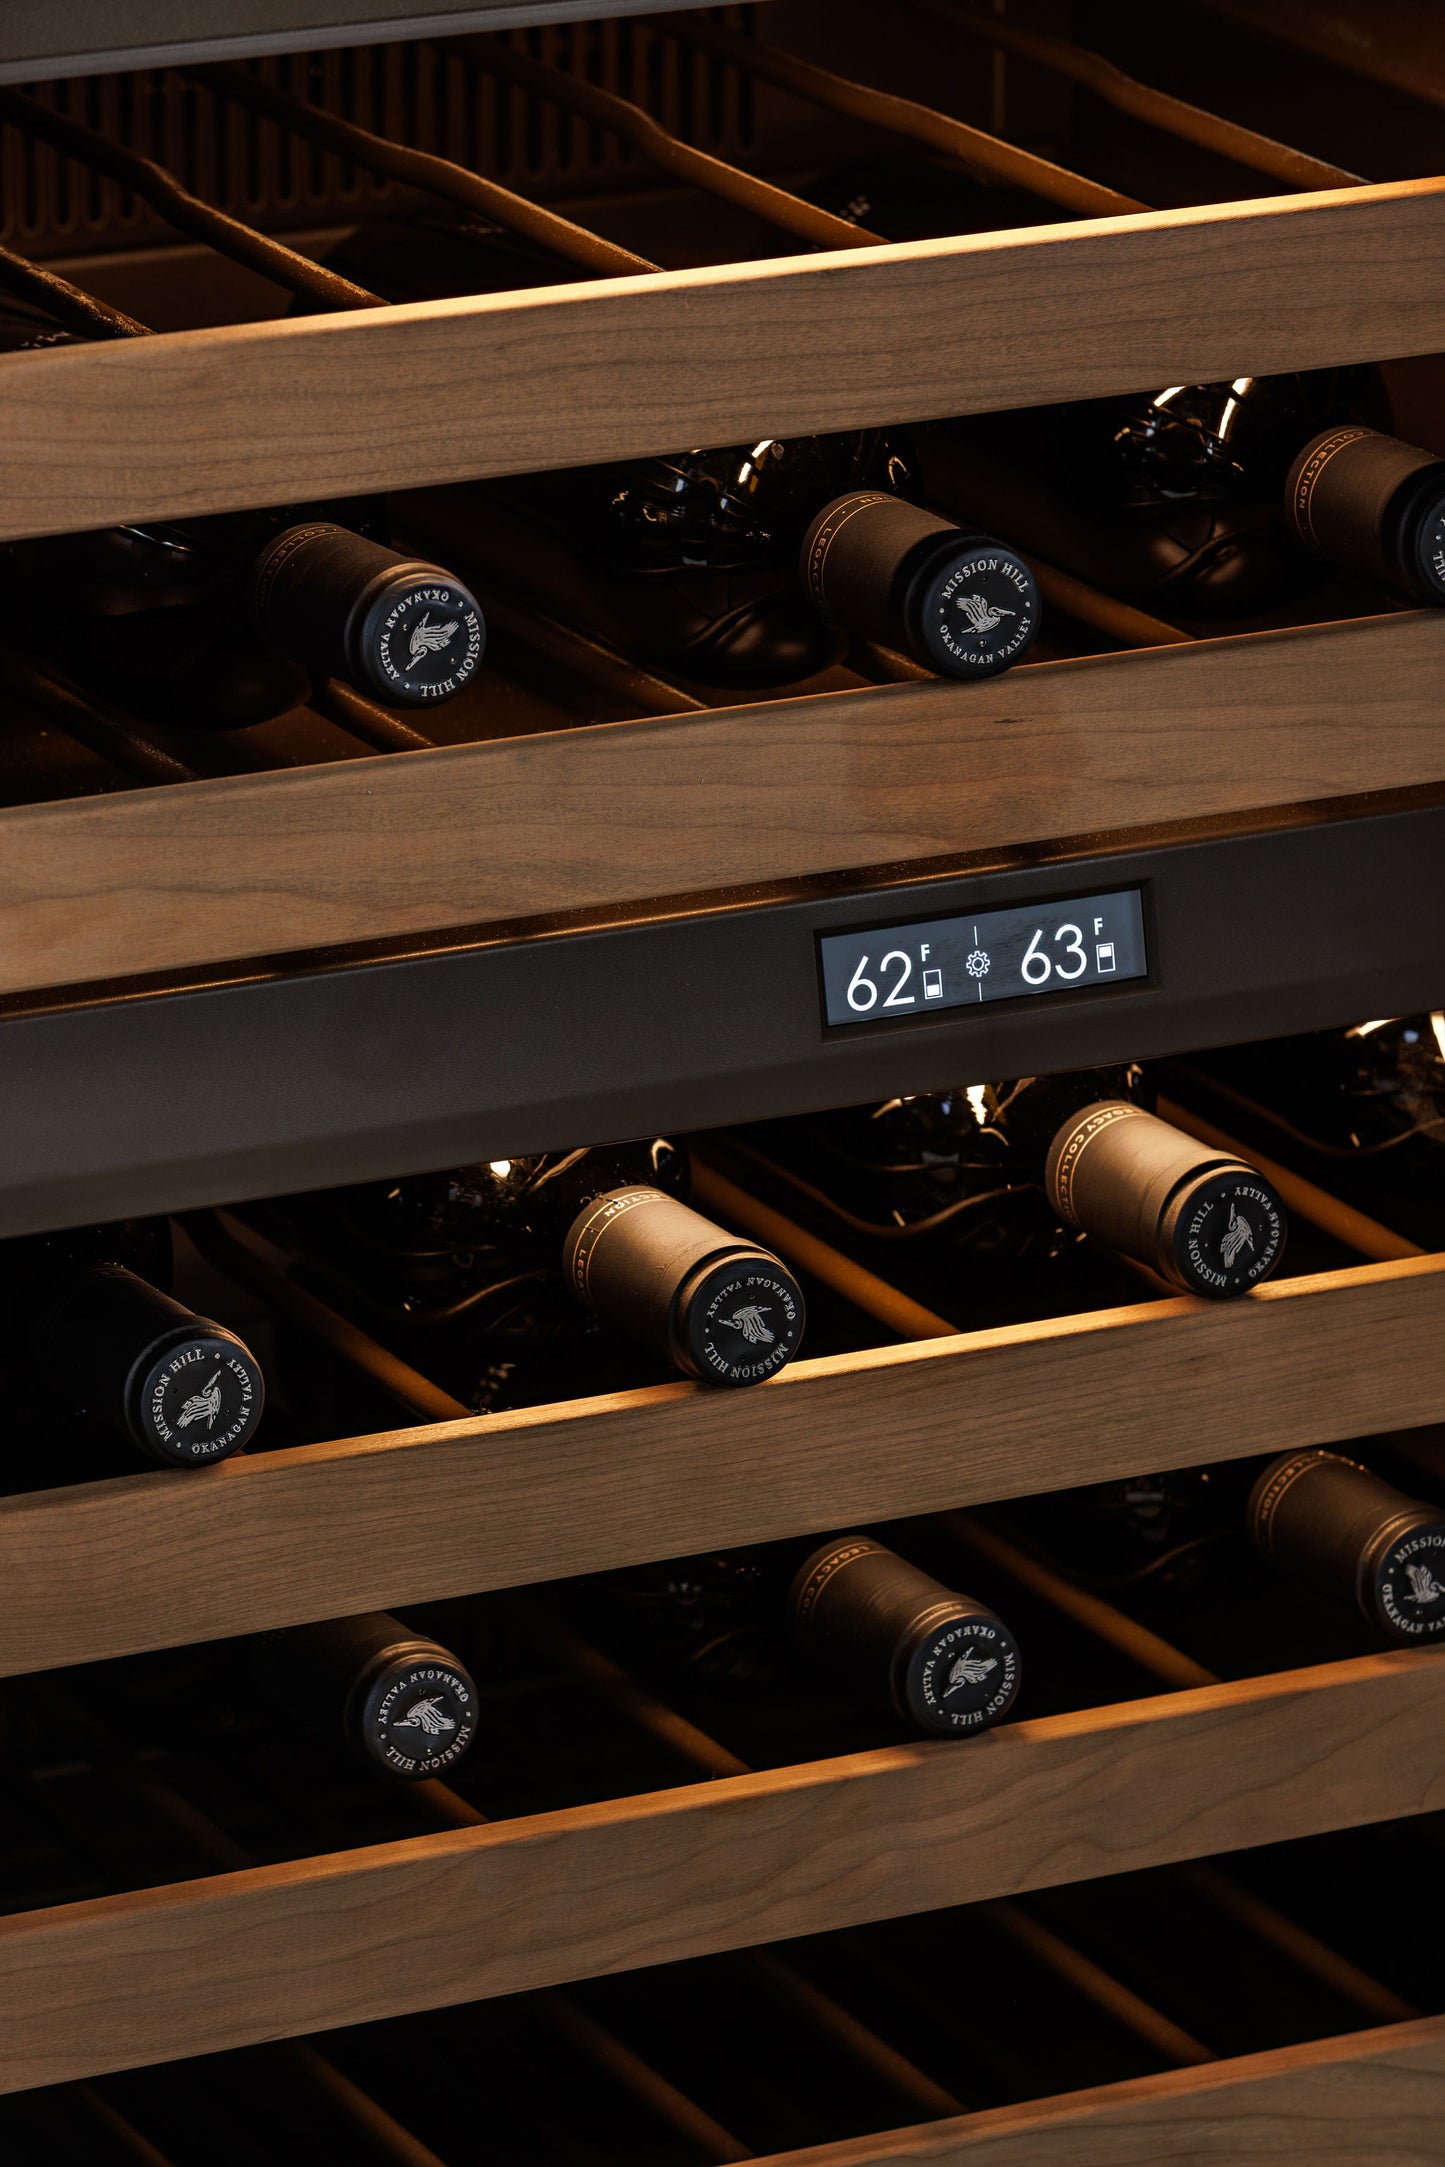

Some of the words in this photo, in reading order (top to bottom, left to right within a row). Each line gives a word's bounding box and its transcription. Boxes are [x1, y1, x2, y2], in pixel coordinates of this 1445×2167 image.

[941, 559, 998, 599] MISSION
[1001, 562, 1030, 593] HILL
[385, 589, 450, 629] OKANAGAN
[380, 632, 400, 680] VALLEY
[455, 611, 481, 681] MISSION
[940, 624, 994, 664] OKANAGAN
[997, 617, 1031, 658] VALLEY
[420, 678, 456, 697] HILL
[1021, 923, 1087, 985] 63
[1093, 917, 1104, 935] F
[846, 950, 915, 1012] 62
[920, 943, 931, 962] F
[1189, 1201, 1214, 1234] HILL
[1234, 1187, 1272, 1211] VALLEY
[1188, 1240, 1227, 1287] MISSION
[1248, 1212, 1280, 1278] OKANAGAN
[707, 1281, 742, 1318] VALLEY
[746, 1277, 796, 1319] OKANAGAN
[704, 1342, 729, 1374] HILL
[730, 1343, 789, 1379] MISSION
[152, 1373, 173, 1441] MISSION
[169, 1348, 205, 1374] HILL
[192, 1406, 251, 1454] OKANAGAN
[226, 1358, 252, 1402] VALLEY
[933, 1625, 996, 1656] OKANAGAN
[378, 1681, 407, 1724] VALLEY
[410, 1669, 469, 1702] OKANAGAN
[923, 1660, 937, 1705] VALLEY
[986, 1652, 1016, 1715] MISSION
[951, 1710, 983, 1726] HILL
[386, 1746, 416, 1771] HILL
[419, 1725, 471, 1771] MISSION
